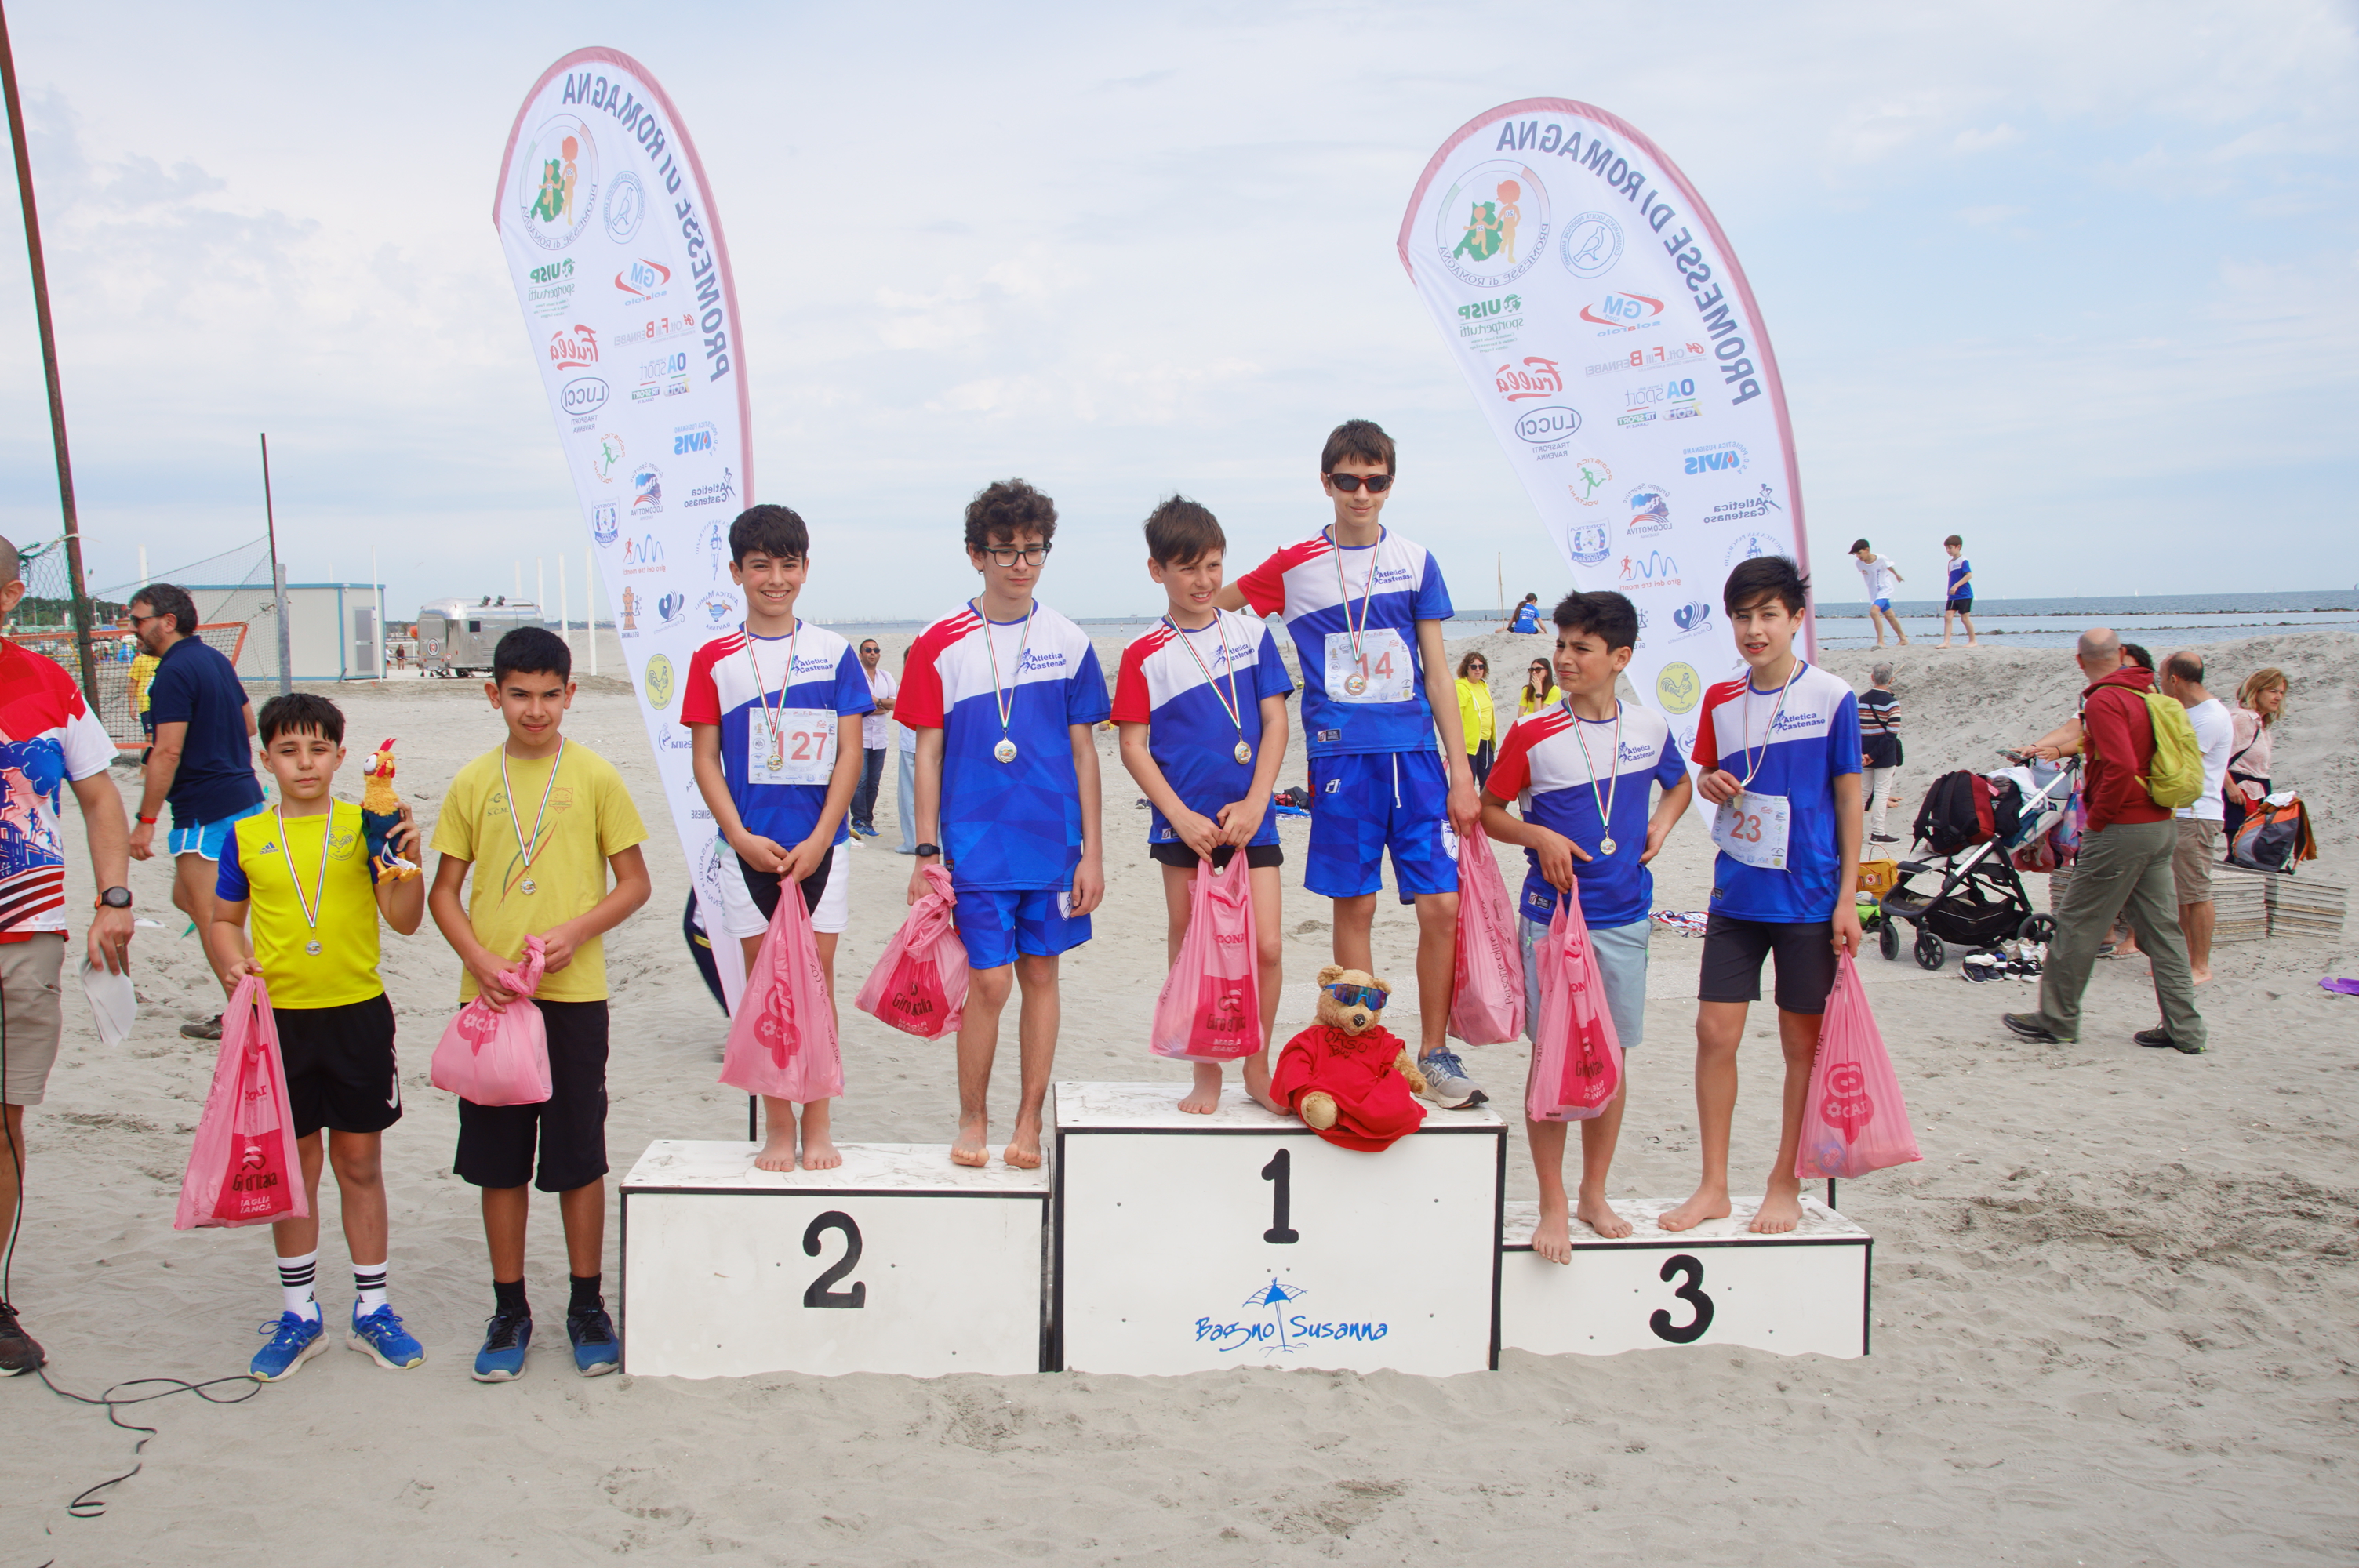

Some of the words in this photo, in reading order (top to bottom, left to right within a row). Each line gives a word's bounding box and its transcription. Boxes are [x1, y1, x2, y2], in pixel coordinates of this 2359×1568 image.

[1379, 568, 1406, 578] Atletica
[1355, 651, 1394, 681] 14
[1782, 718, 1826, 731] Castenaso
[1783, 713, 1817, 724] Atletica
[776, 731, 827, 760] 127
[1627, 745, 1651, 754] Atletica
[1729, 811, 1761, 843] 23
[1485, 923, 1494, 934] le
[1490, 935, 1503, 960] oltre
[1497, 964, 1514, 1004] Persone
[892, 993, 911, 1014] Giro
[1425, 1069, 1445, 1088] N
[1260, 1148, 1299, 1244] 1
[802, 1210, 866, 1308] 2
[1649, 1254, 1714, 1344] 3
[1195, 1316, 1275, 1352] Bagno
[1289, 1315, 1388, 1341] Susanna
